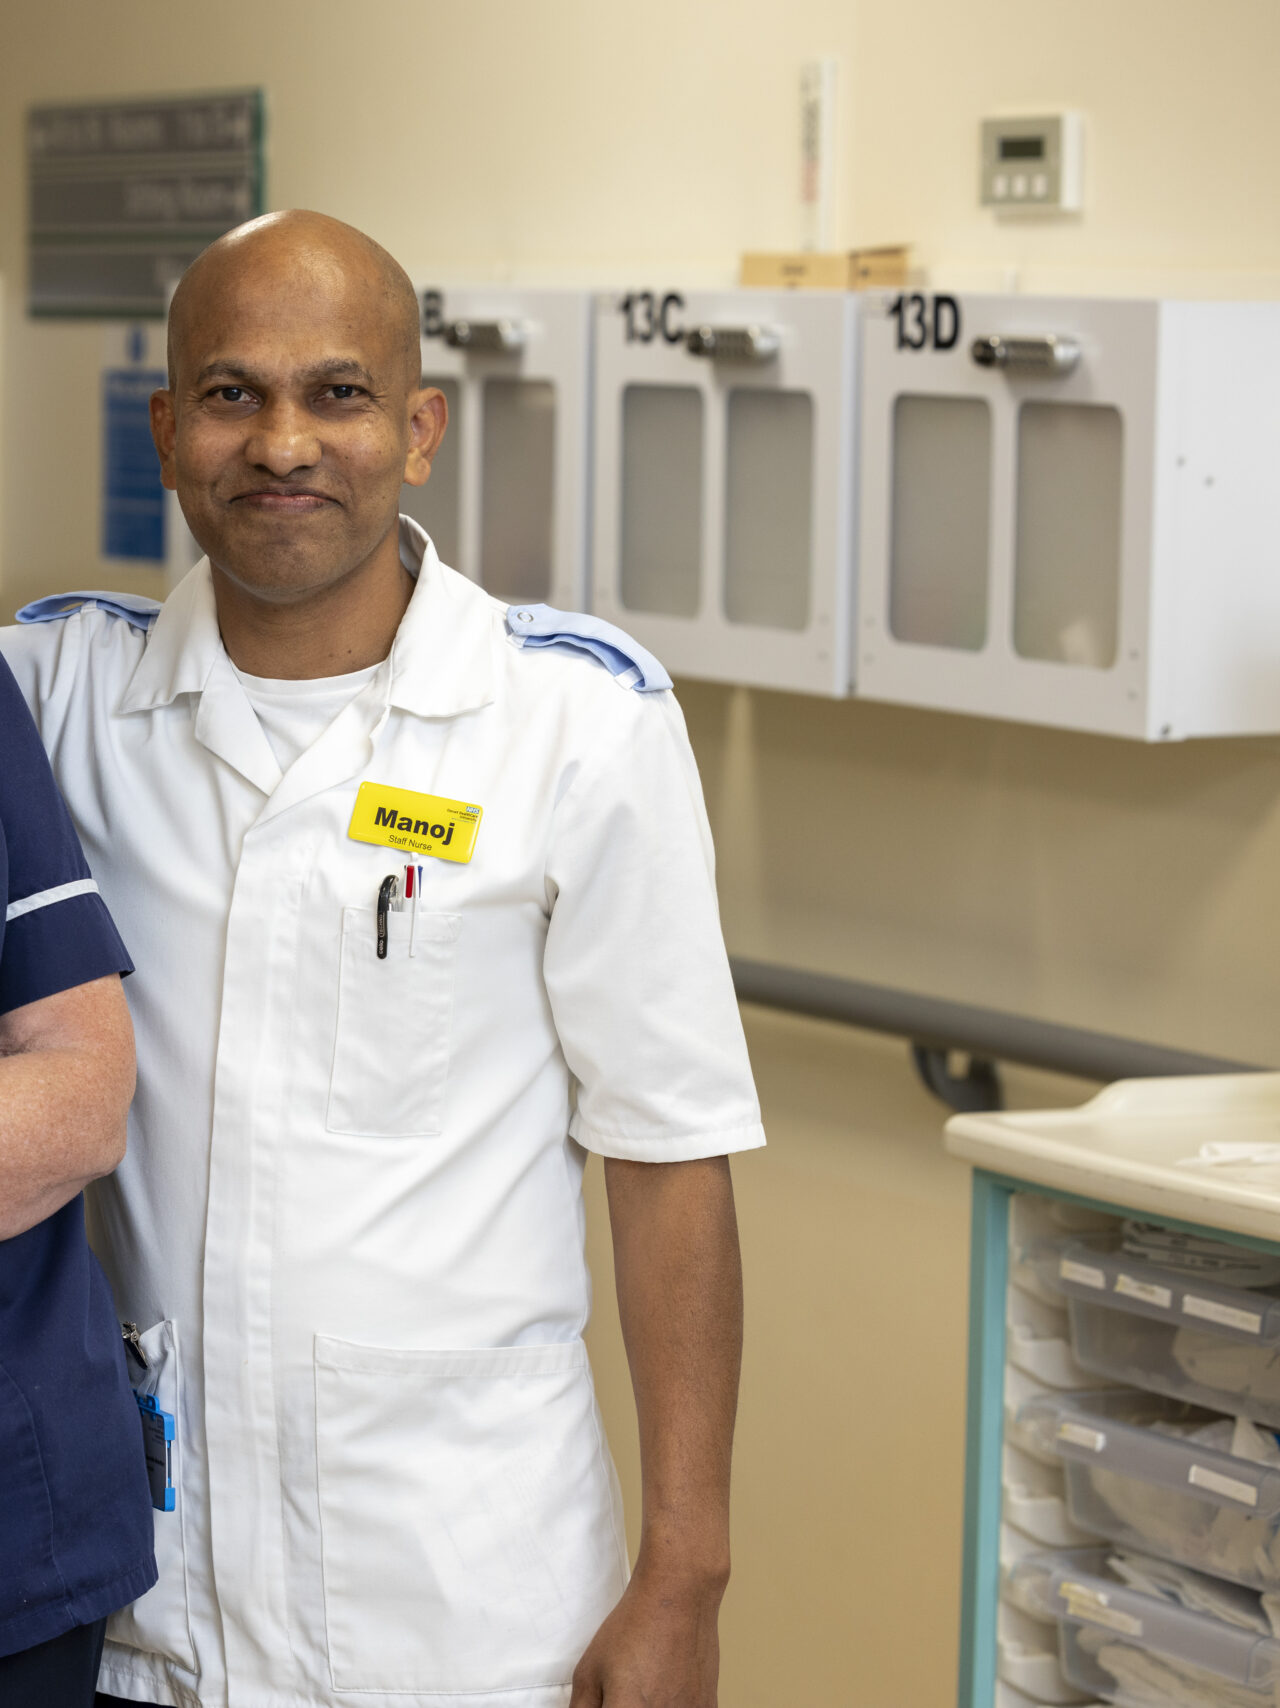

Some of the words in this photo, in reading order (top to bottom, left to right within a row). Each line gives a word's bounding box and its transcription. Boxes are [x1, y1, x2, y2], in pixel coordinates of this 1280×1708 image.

[620, 291, 684, 344] 13C
[888, 294, 960, 350] 13D
[374, 806, 455, 846] Manoj
[388, 835, 407, 847] Staff
[408, 839, 433, 851] Nurse
